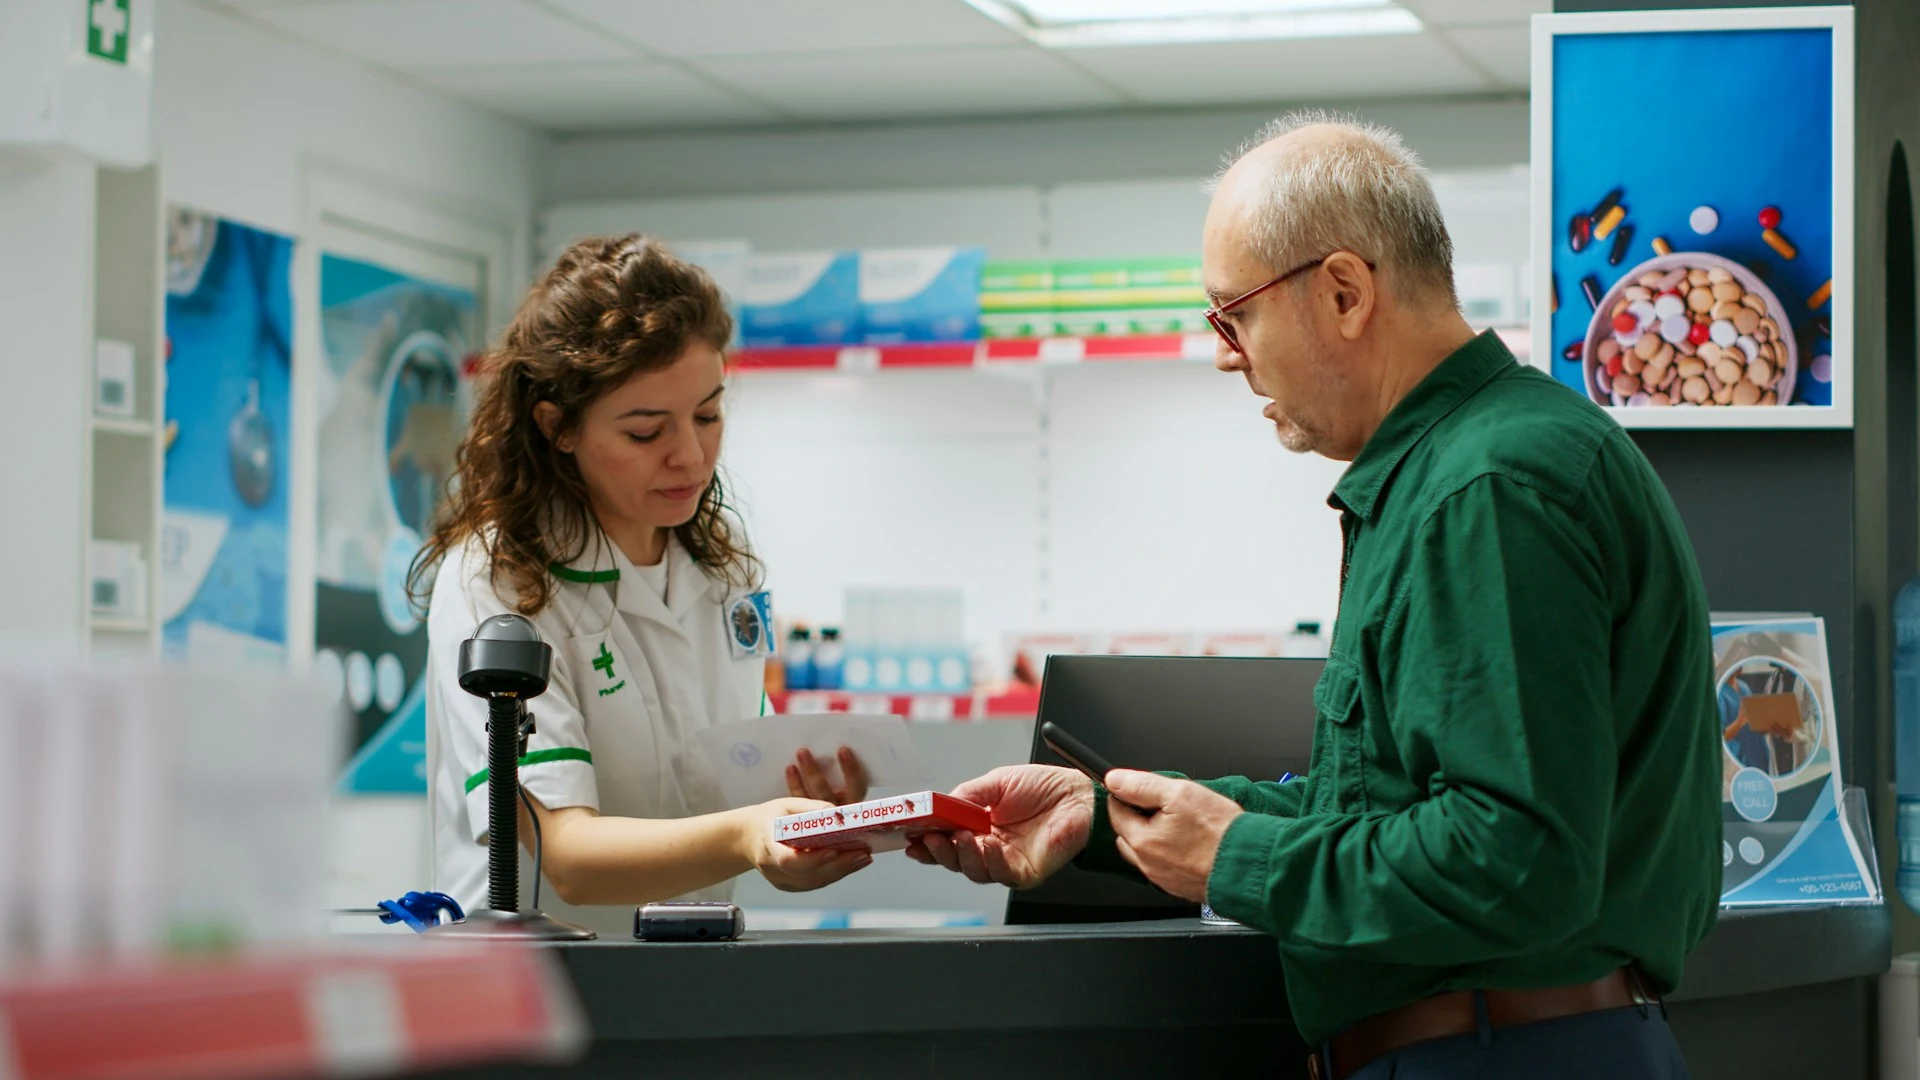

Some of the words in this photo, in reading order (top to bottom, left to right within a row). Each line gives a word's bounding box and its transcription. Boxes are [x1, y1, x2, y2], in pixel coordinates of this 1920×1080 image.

[1736, 780, 1766, 792] FREE
[1742, 797, 1769, 808] CALL
[861, 804, 904, 819] CARDIO
[792, 816, 834, 832] CARDIO
